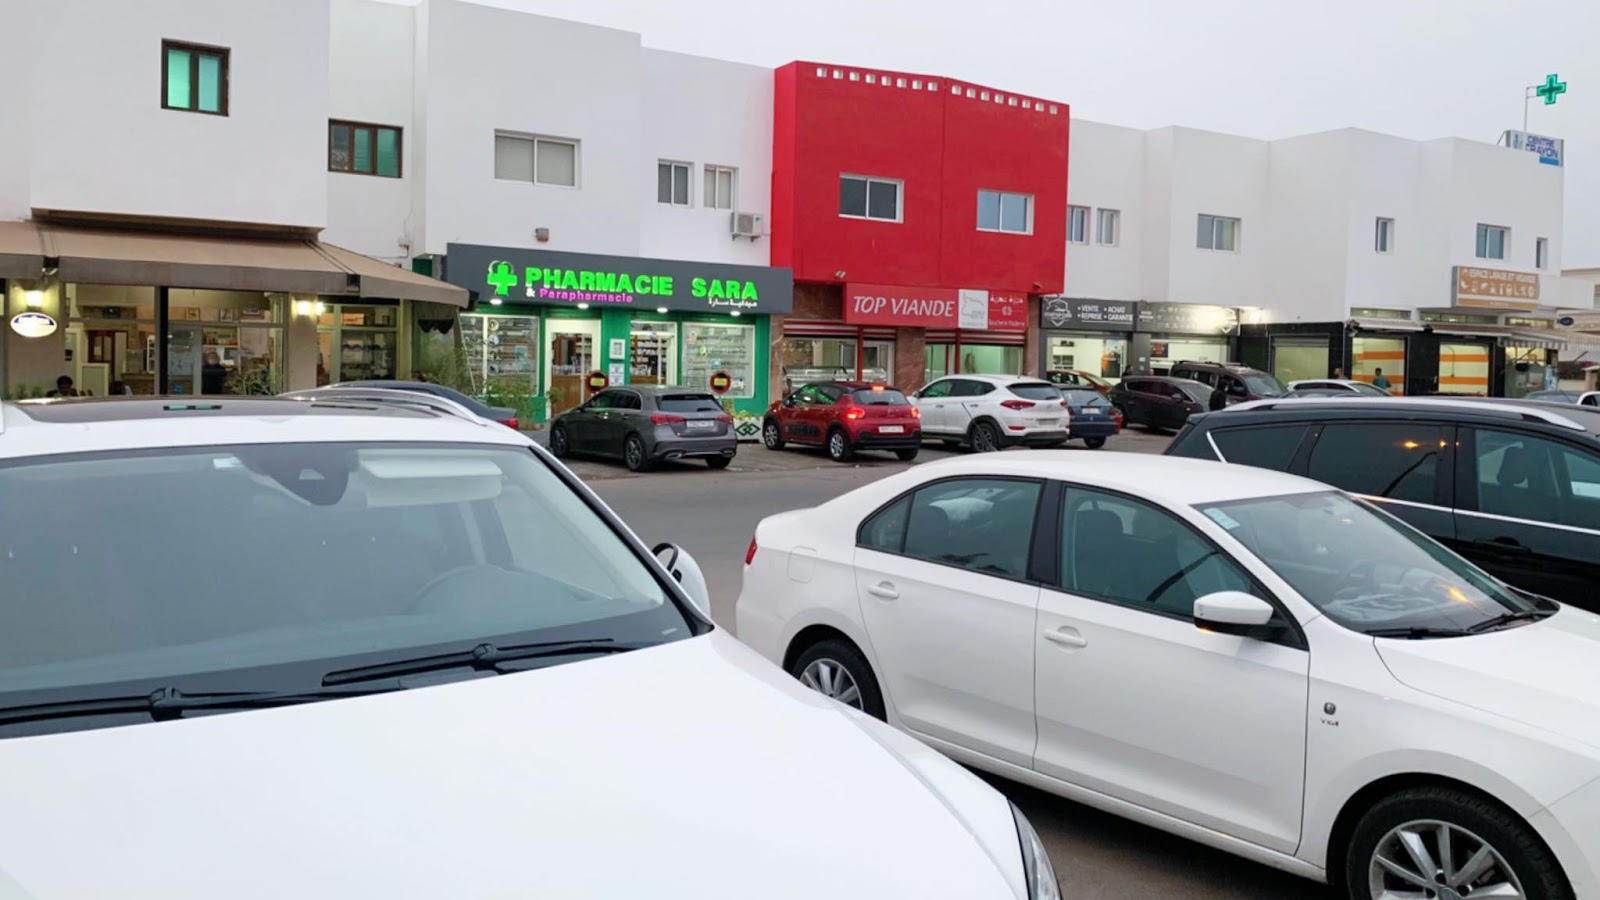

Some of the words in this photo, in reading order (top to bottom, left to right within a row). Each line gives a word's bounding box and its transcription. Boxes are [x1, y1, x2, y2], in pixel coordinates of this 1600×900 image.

[525, 267, 673, 295] PHARMACIE
[691, 277, 758, 300] SARA
[526, 287, 535, 298] &
[539, 288, 633, 304] Parapharmacie
[853, 295, 887, 314] TOP
[891, 298, 955, 317] VIANDE
[1081, 305, 1099, 313] VENTE
[1107, 306, 1125, 314] ACHAT
[1081, 312, 1102, 320] REPRISE
[1107, 313, 1133, 321] GARANTIE
